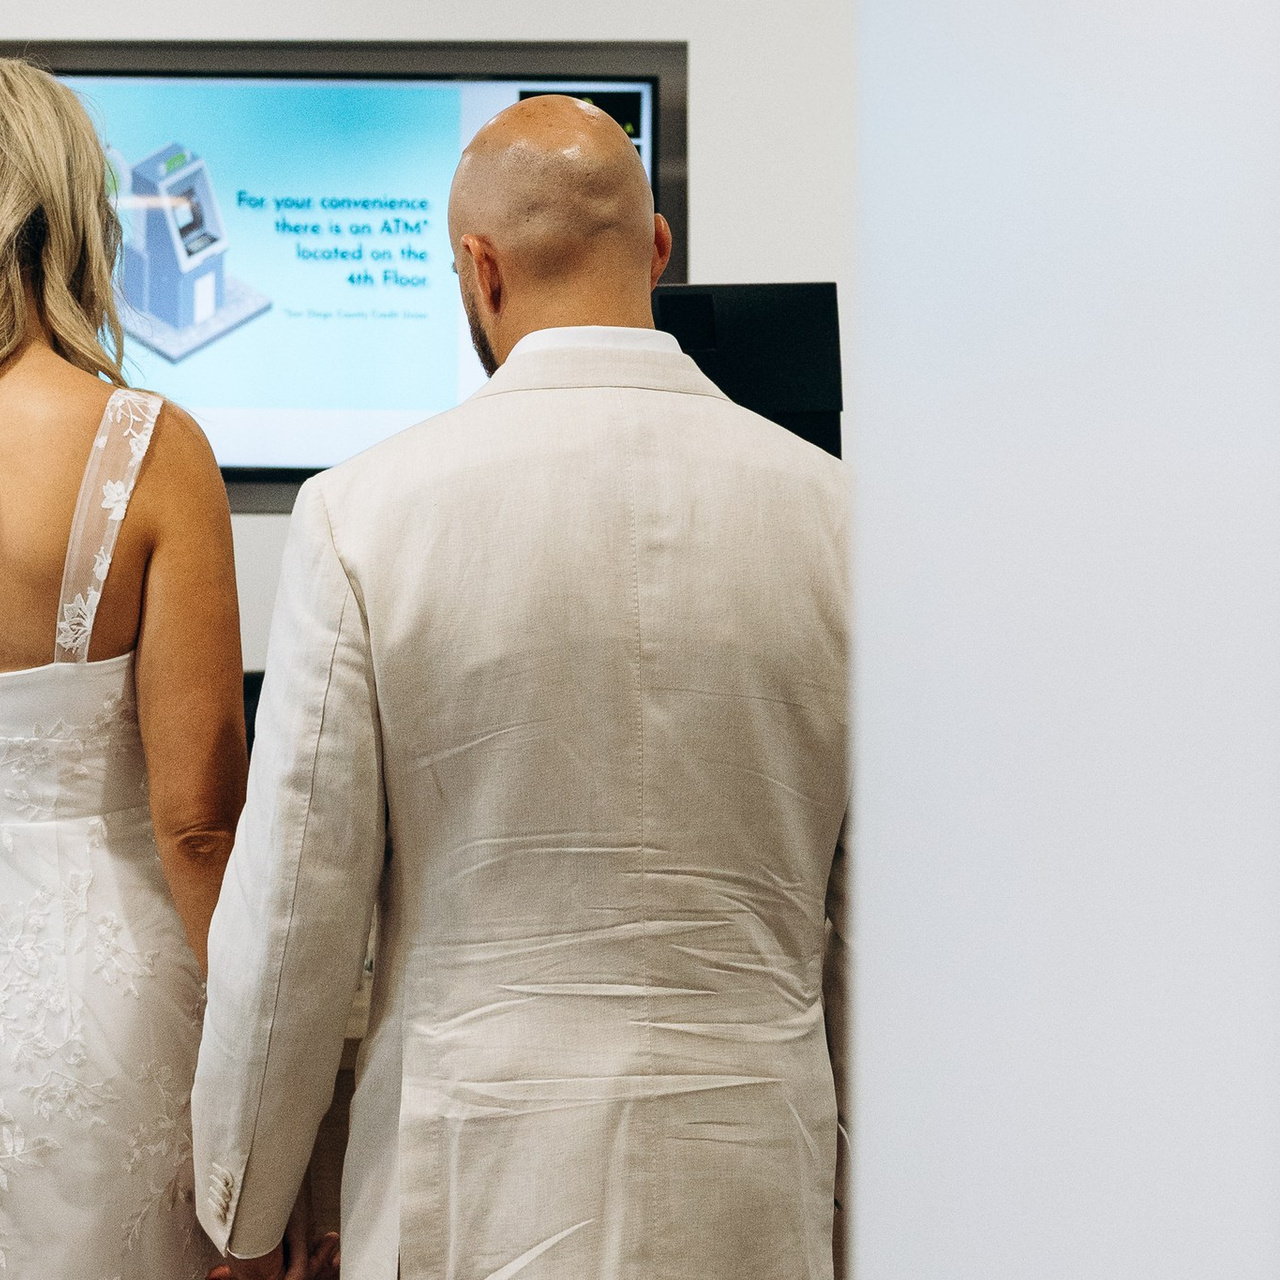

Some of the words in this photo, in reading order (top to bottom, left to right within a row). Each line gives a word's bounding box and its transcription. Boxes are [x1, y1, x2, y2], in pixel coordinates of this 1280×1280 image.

[237, 190, 265, 208] For
[274, 197, 311, 211] your
[321, 195, 428, 209] convenience
[276, 217, 320, 234] there
[330, 220, 341, 234] is
[350, 223, 372, 235] an
[296, 243, 363, 260] located
[371, 249, 392, 260] on
[401, 244, 428, 260] the
[348, 269, 374, 285] 4th
[383, 269, 427, 286] Floor
